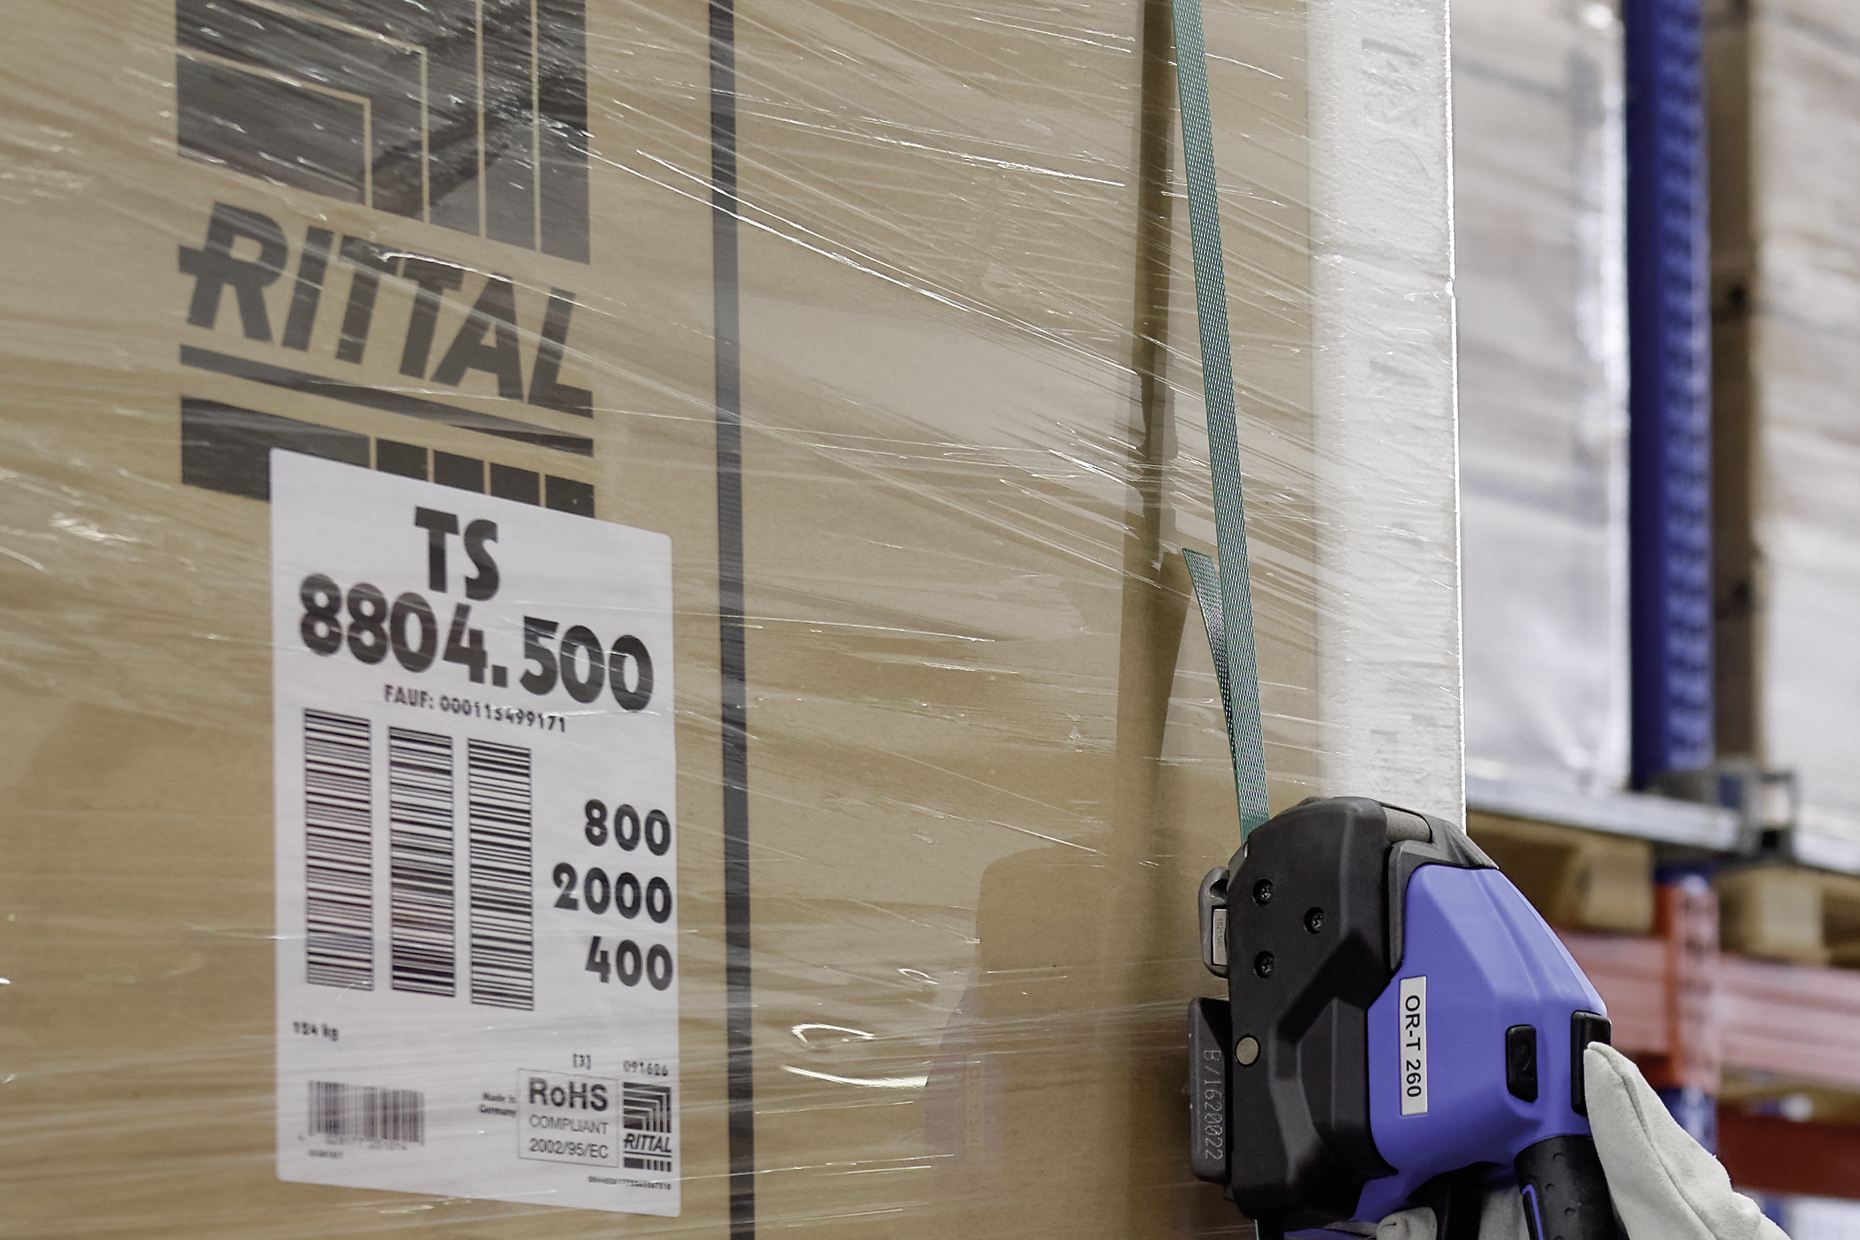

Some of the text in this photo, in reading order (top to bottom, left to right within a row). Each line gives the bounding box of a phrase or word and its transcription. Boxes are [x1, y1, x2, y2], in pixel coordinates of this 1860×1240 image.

[178, 201, 595, 420] RITTAL
[415, 506, 500, 601] TS
[300, 573, 654, 713] 8804.500
[384, 684, 434, 709] FAUF:
[585, 799, 671, 857] 800
[553, 862, 673, 924] 2000
[585, 936, 674, 991] 400
[1405, 994, 1422, 1098] OR-T 260
[479, 1104, 518, 1118] Germany
[528, 1077, 609, 1112] RoHS
[529, 1114, 609, 1134] COMPLIANT
[529, 1138, 610, 1159] 2002/95/EC
[623, 1133, 672, 1153] RITTAL
